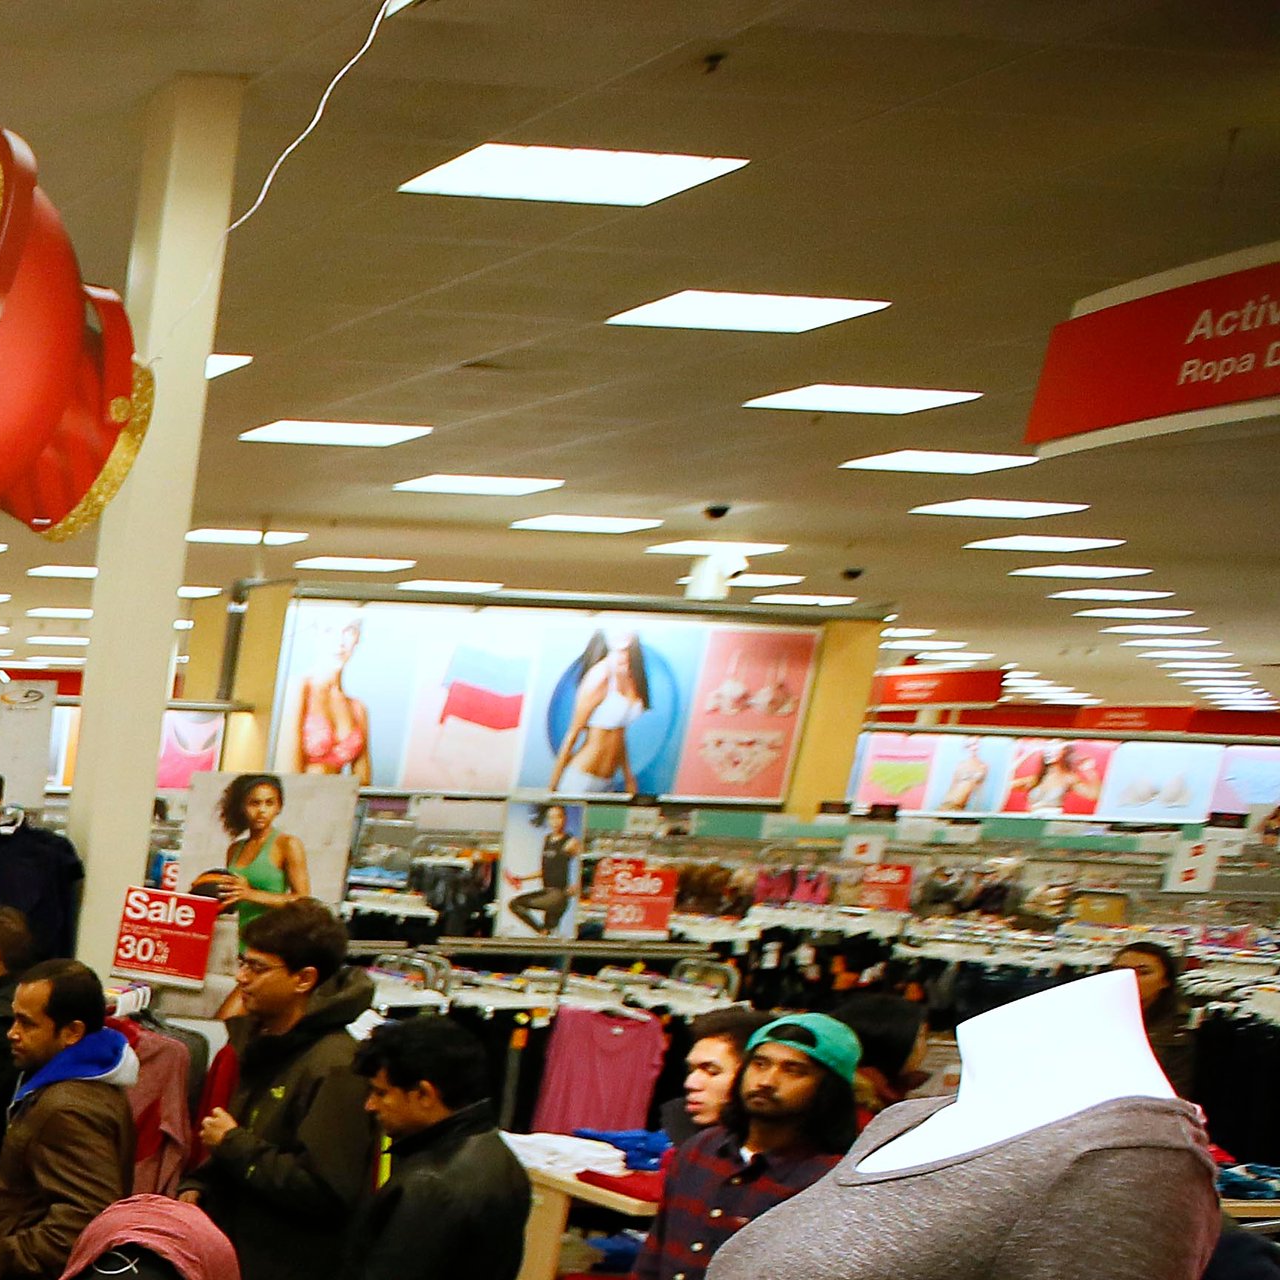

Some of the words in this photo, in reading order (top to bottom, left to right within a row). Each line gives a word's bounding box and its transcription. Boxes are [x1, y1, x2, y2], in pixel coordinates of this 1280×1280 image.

[1177, 353, 1256, 386] Ropa
[614, 871, 663, 895] Sale
[125, 891, 196, 927] Sale
[118, 934, 156, 962] 30
